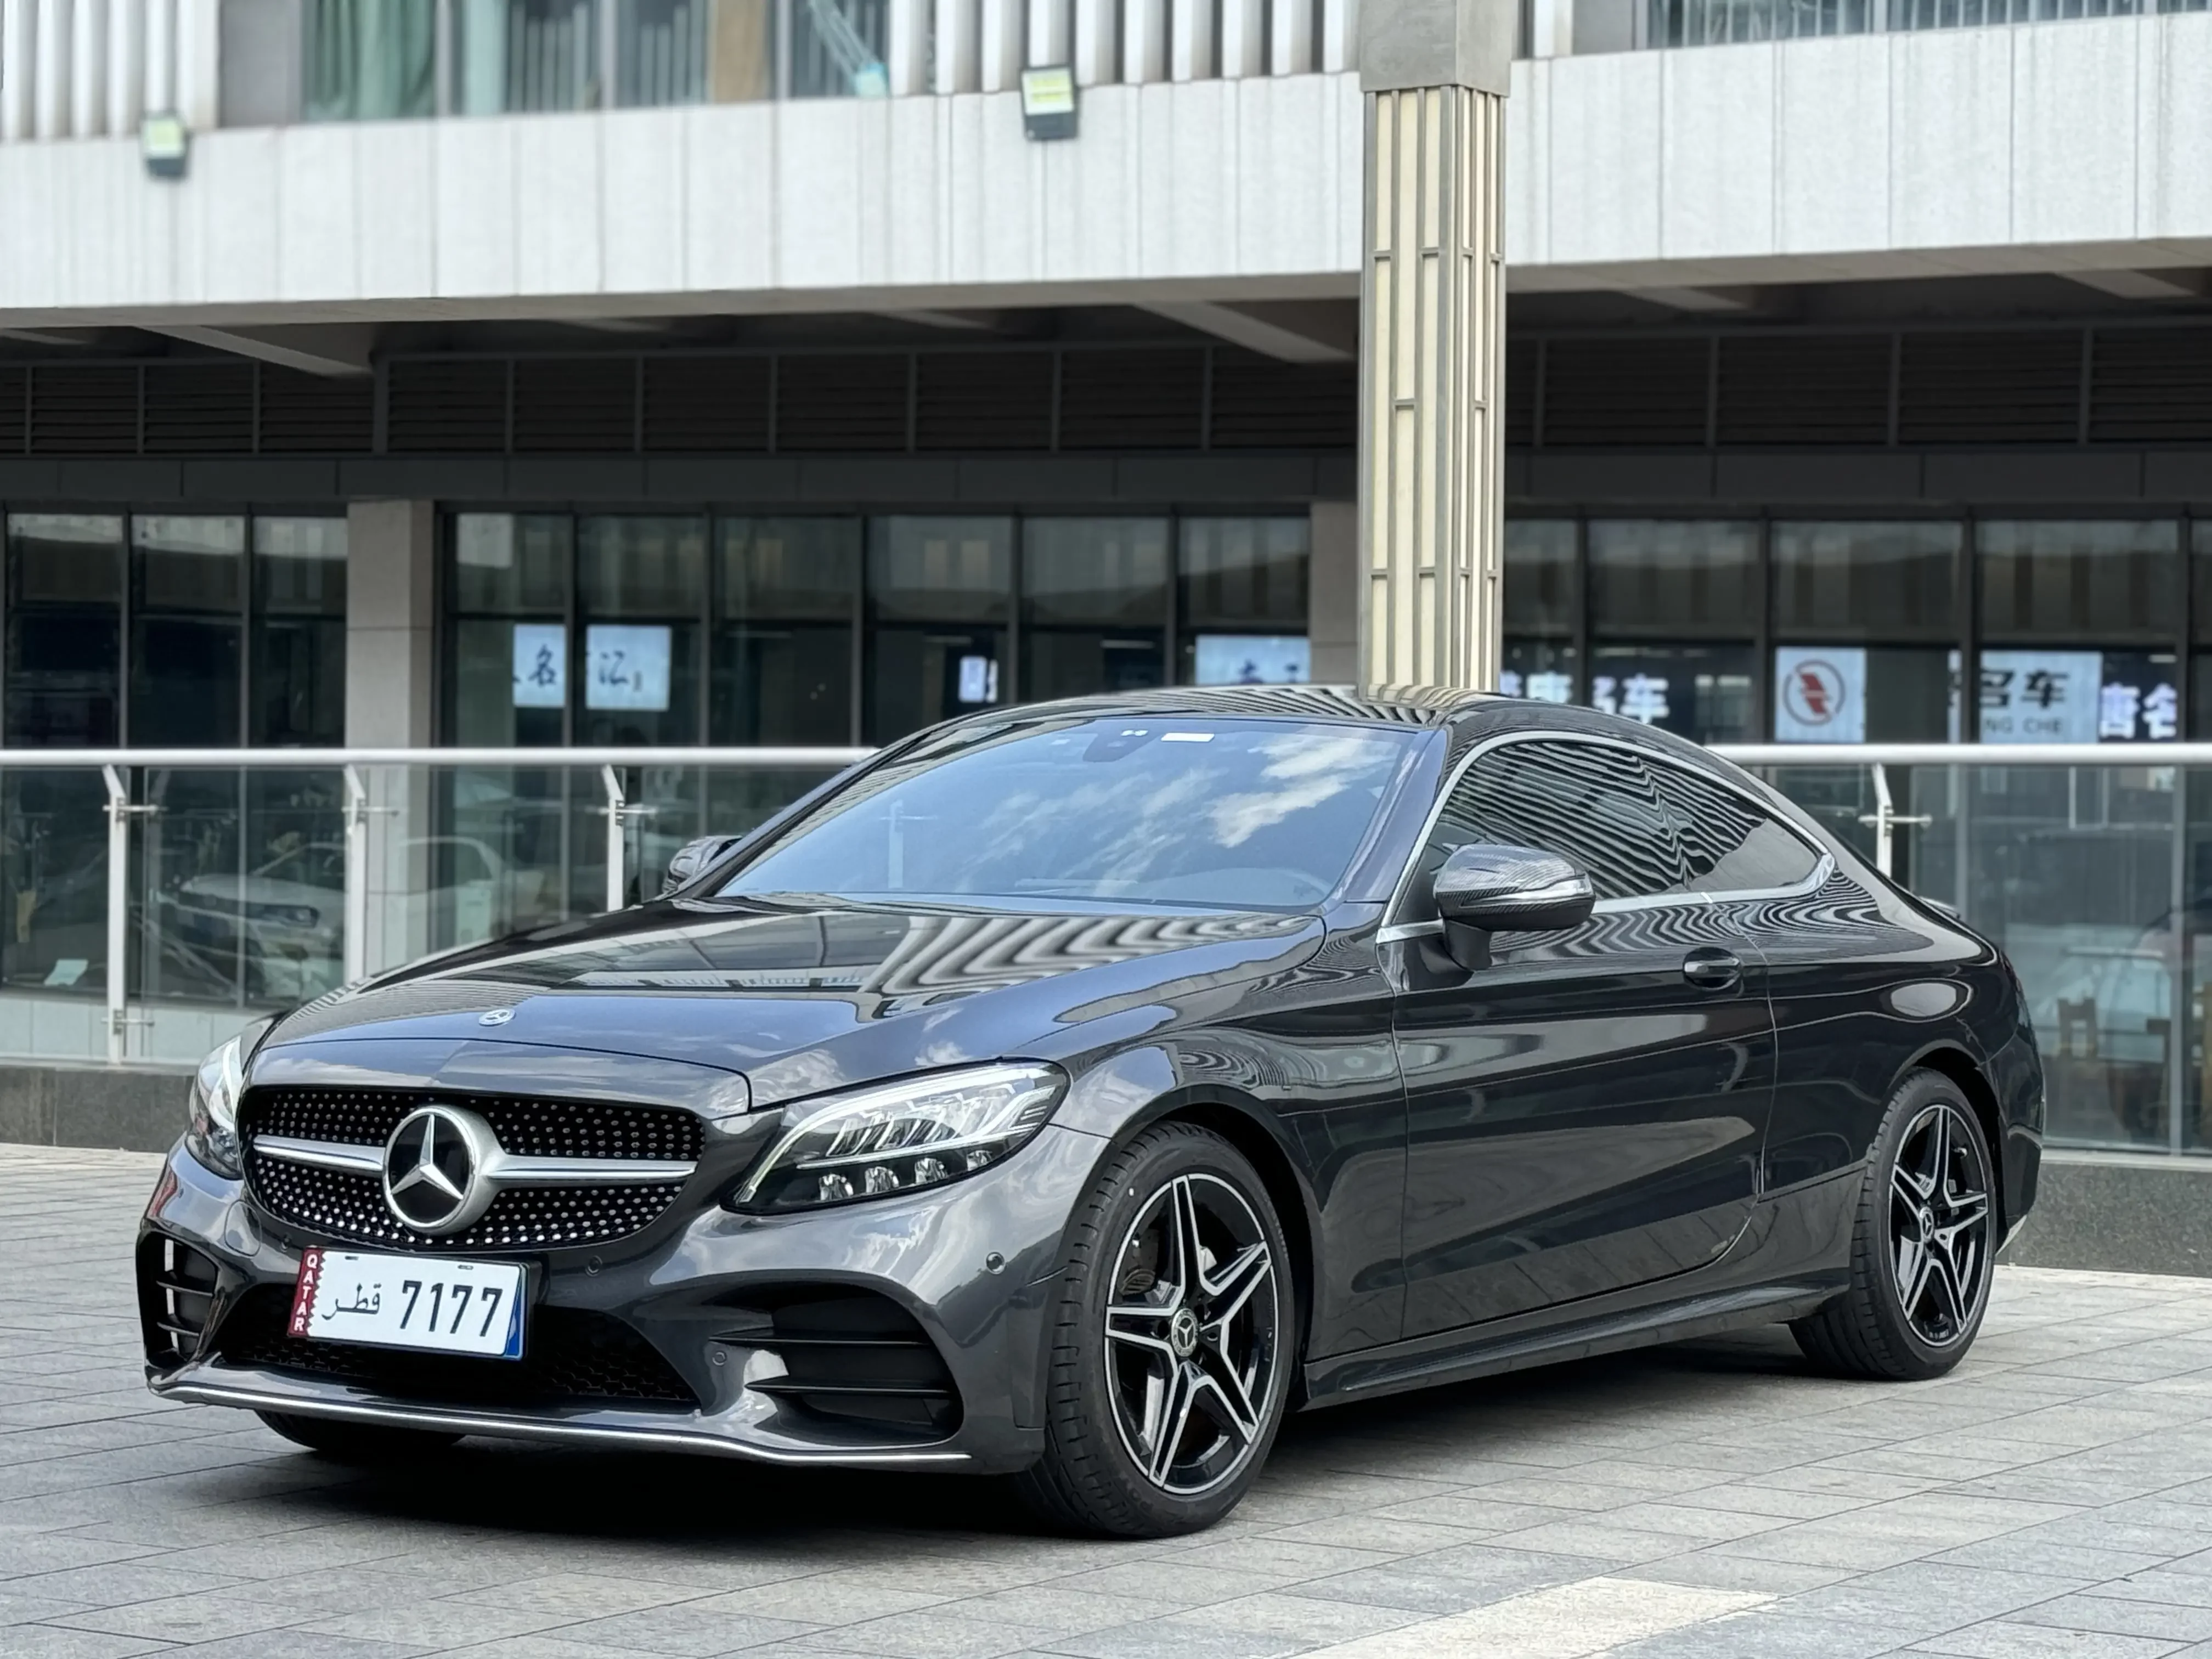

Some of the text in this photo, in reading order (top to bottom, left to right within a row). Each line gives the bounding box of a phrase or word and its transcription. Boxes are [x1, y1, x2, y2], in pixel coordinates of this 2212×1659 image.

[294, 1253, 318, 1331] QATAR
[321, 1280, 503, 1337] قطر 7177
